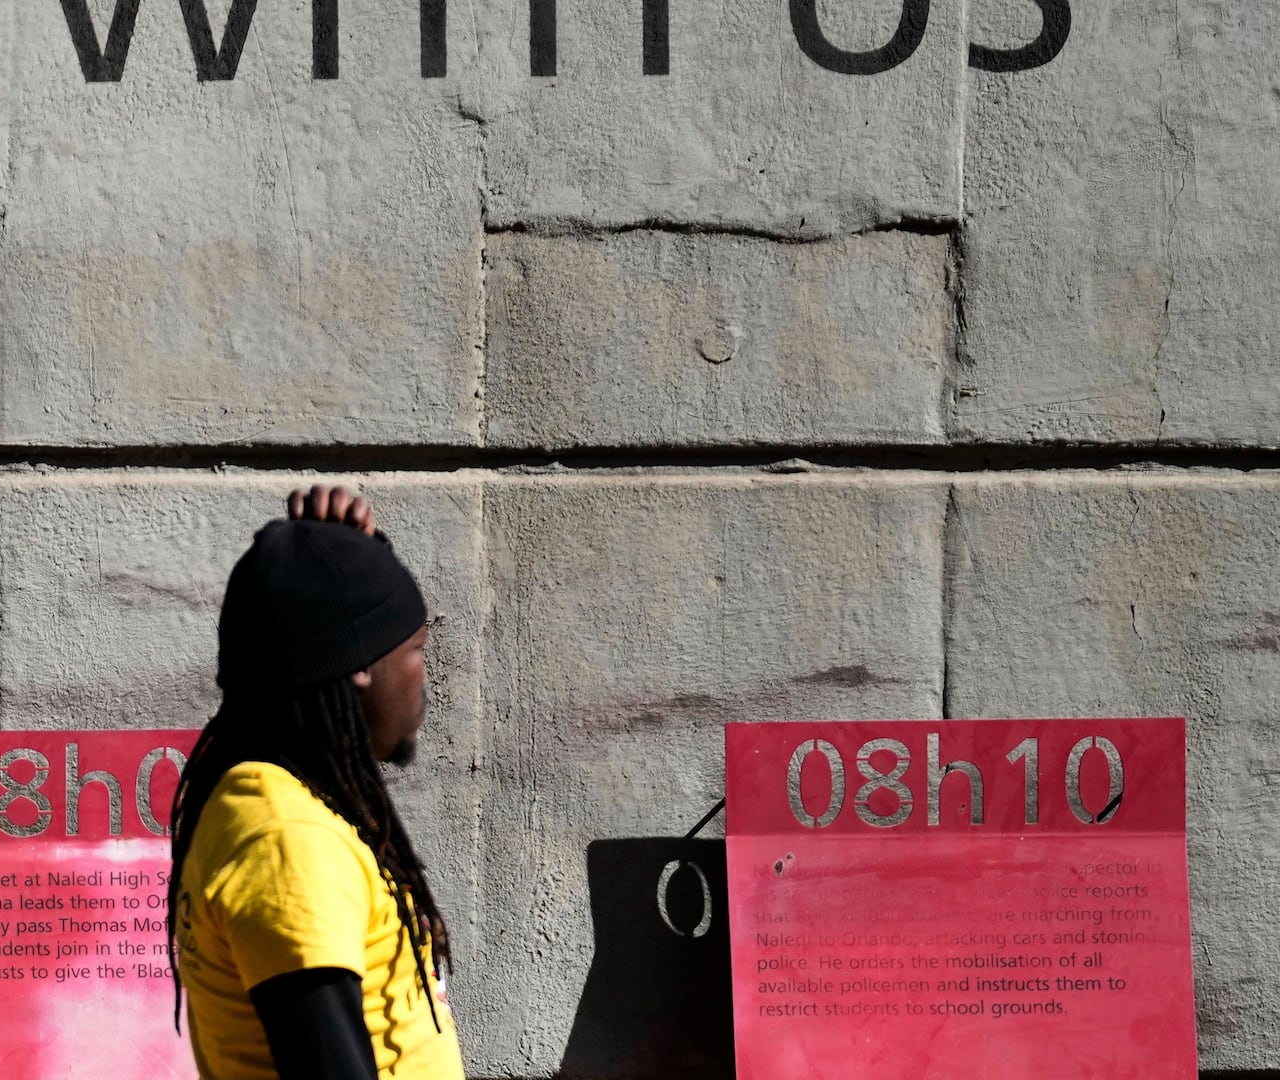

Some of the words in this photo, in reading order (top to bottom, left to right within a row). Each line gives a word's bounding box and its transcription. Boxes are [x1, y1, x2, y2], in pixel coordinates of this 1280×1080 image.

[786, 732, 1124, 828] 08h10
[23, 873, 41, 888] at
[47, 870, 103, 887] Naledi
[109, 870, 150, 890] High
[1064, 863, 1139, 882] spector
[19, 893, 65, 911] leads
[70, 893, 116, 910] them
[121, 895, 141, 910] to
[1029, 884, 1078, 903] poice
[1084, 883, 1149, 901] reports
[1023, 908, 1104, 925] marching
[1109, 906, 1152, 921] from
[16, 920, 52, 937] pass
[57, 916, 128, 933] Thomas
[55, 940, 89, 959] join
[95, 940, 111, 956] in
[116, 940, 147, 956] the
[926, 929, 1007, 950] attacking
[1012, 932, 1047, 945] cars
[1052, 929, 1086, 945] and
[29, 965, 49, 980] to
[54, 964, 91, 983] give
[95, 963, 127, 979] the
[757, 954, 811, 975] police.
[819, 955, 843, 970] He
[849, 954, 905, 970] orders
[910, 953, 939, 969] the
[945, 952, 1053, 969] mobilisation
[1058, 951, 1078, 968] of
[1083, 951, 1103, 968] all
[757, 977, 834, 994] available
[840, 976, 930, 996] policemen
[936, 976, 970, 992] and
[975, 975, 1051, 992] instructs
[1054, 974, 1102, 992] them
[1106, 975, 1127, 991] to
[758, 1000, 819, 1018] restrict
[824, 1000, 900, 1017] students
[904, 1001, 924, 1017] to
[929, 999, 985, 1017] school
[990, 998, 1068, 1019] grounds.
